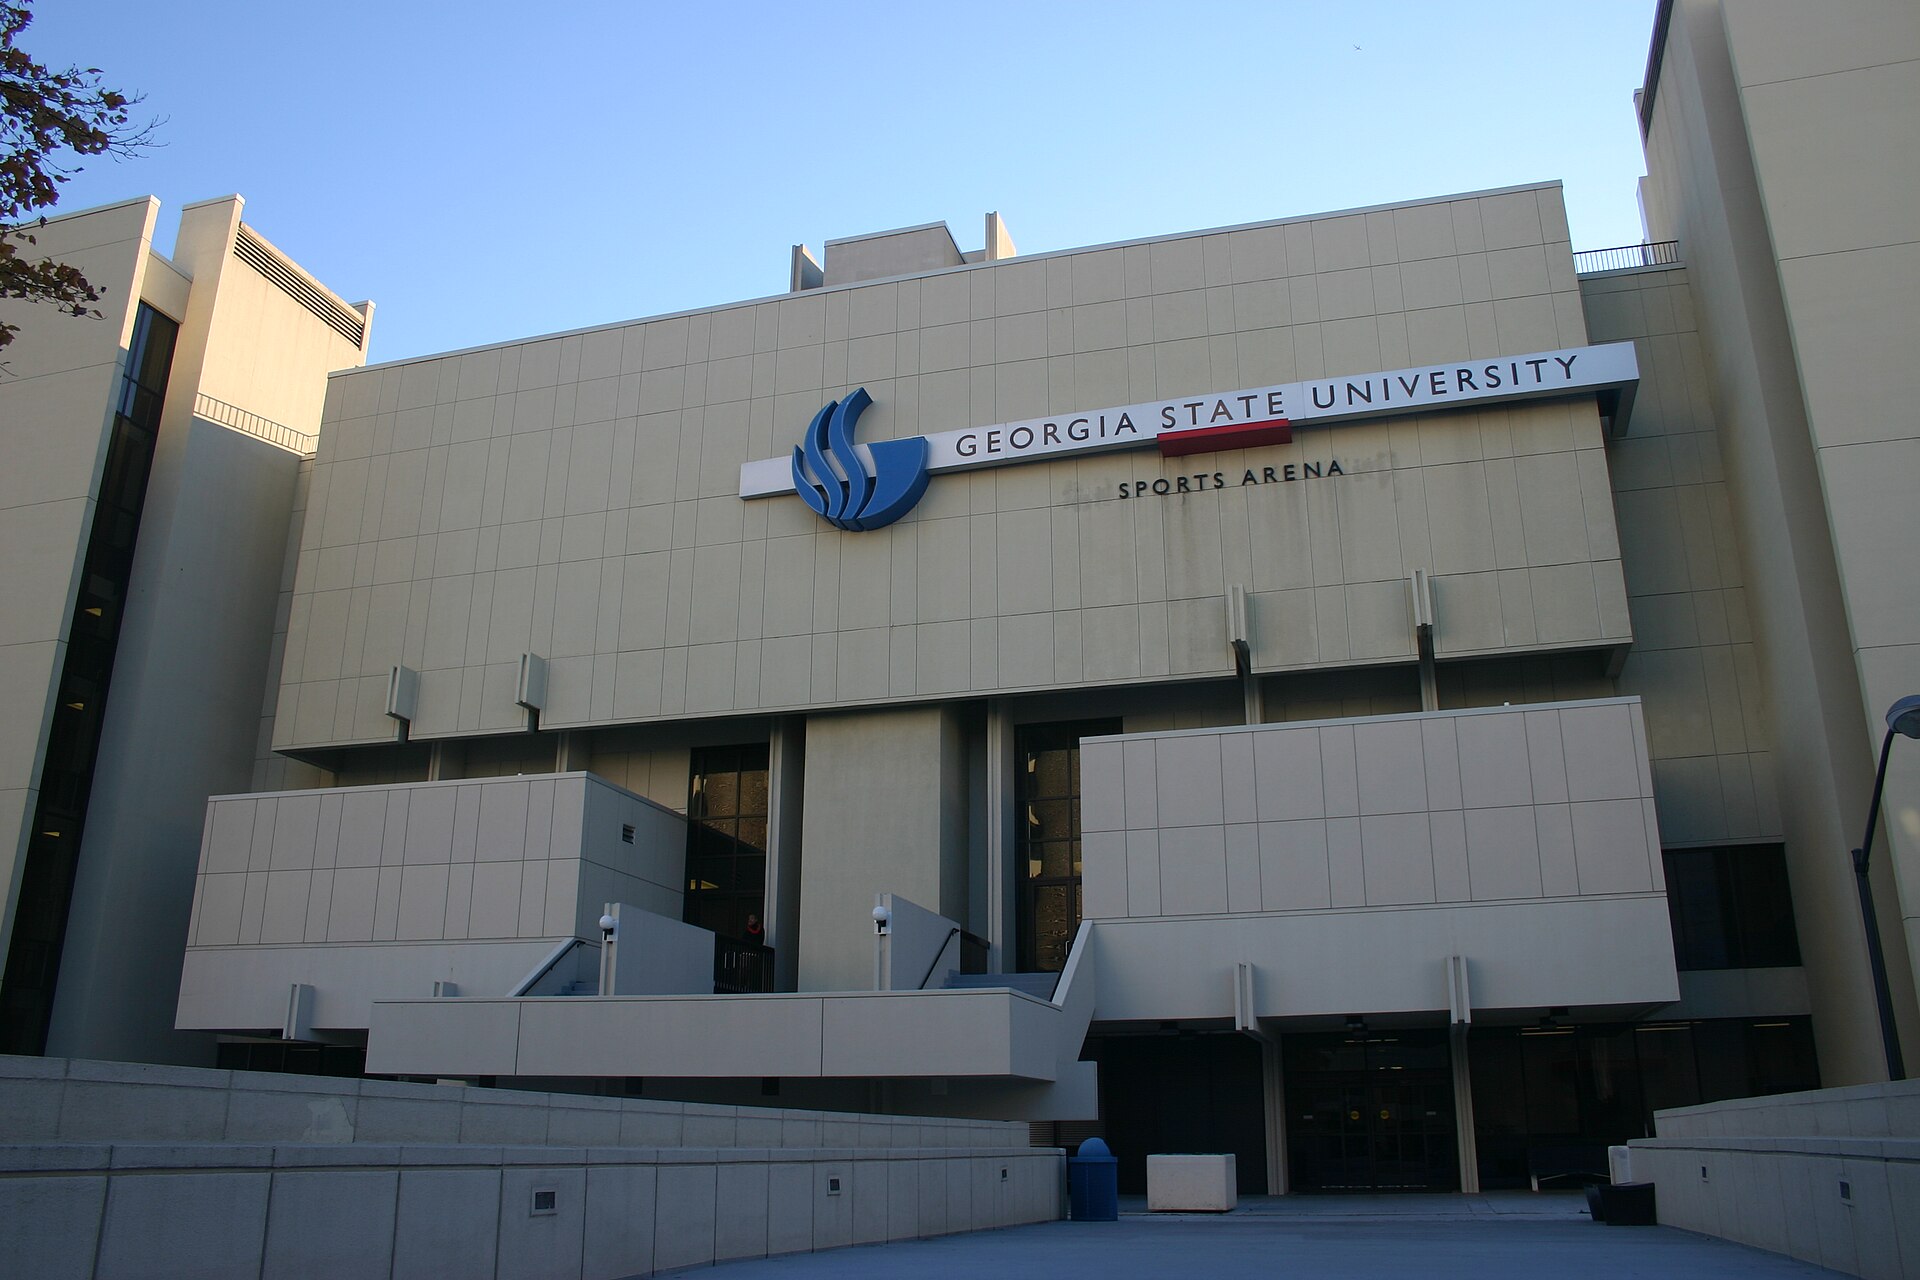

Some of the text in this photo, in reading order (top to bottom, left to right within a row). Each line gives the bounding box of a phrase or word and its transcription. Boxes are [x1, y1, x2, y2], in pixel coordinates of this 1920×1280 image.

[956, 355, 1578, 457] GEORGIA STATE UNIVERSITY
[1118, 459, 1344, 500] SPORTS ARENA
